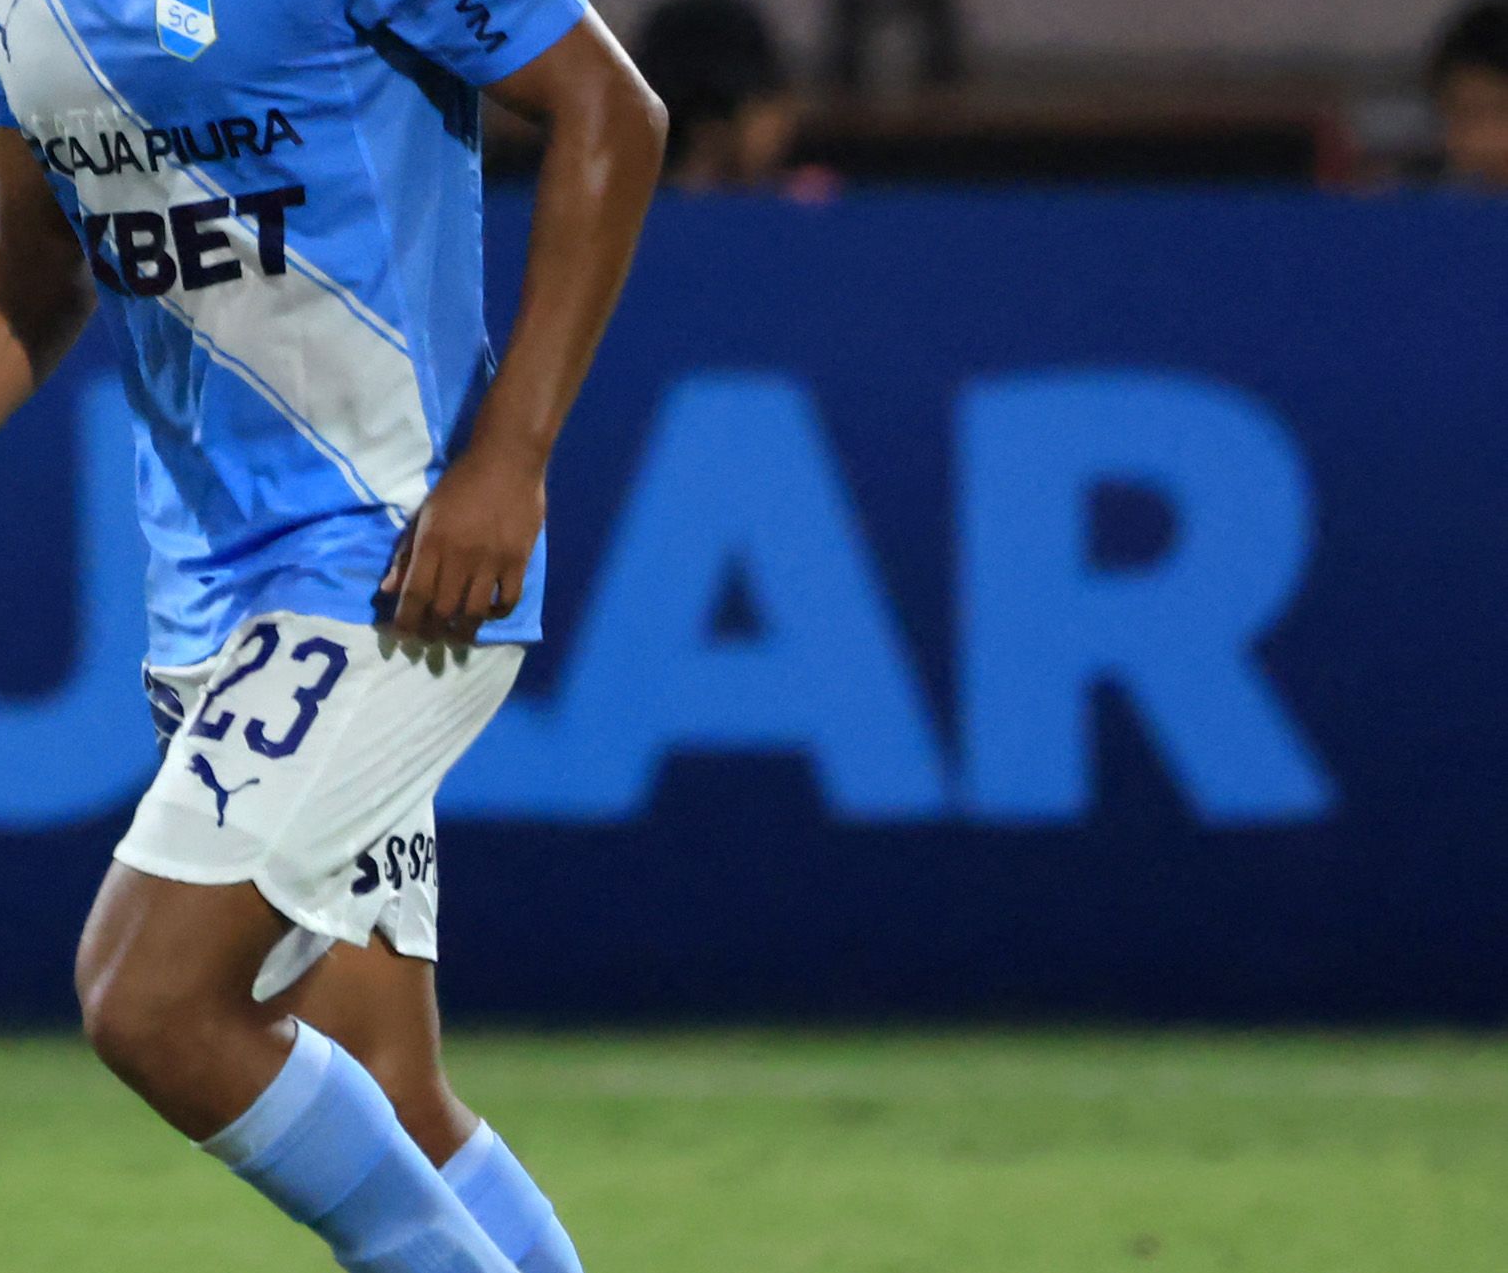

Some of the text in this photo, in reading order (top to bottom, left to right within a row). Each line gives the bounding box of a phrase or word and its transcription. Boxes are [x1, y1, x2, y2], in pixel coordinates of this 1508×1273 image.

[168, 5, 201, 36] SC
[44, 131, 145, 176] CAJA
[145, 108, 304, 172] PIURA
[188, 623, 350, 760] 23
